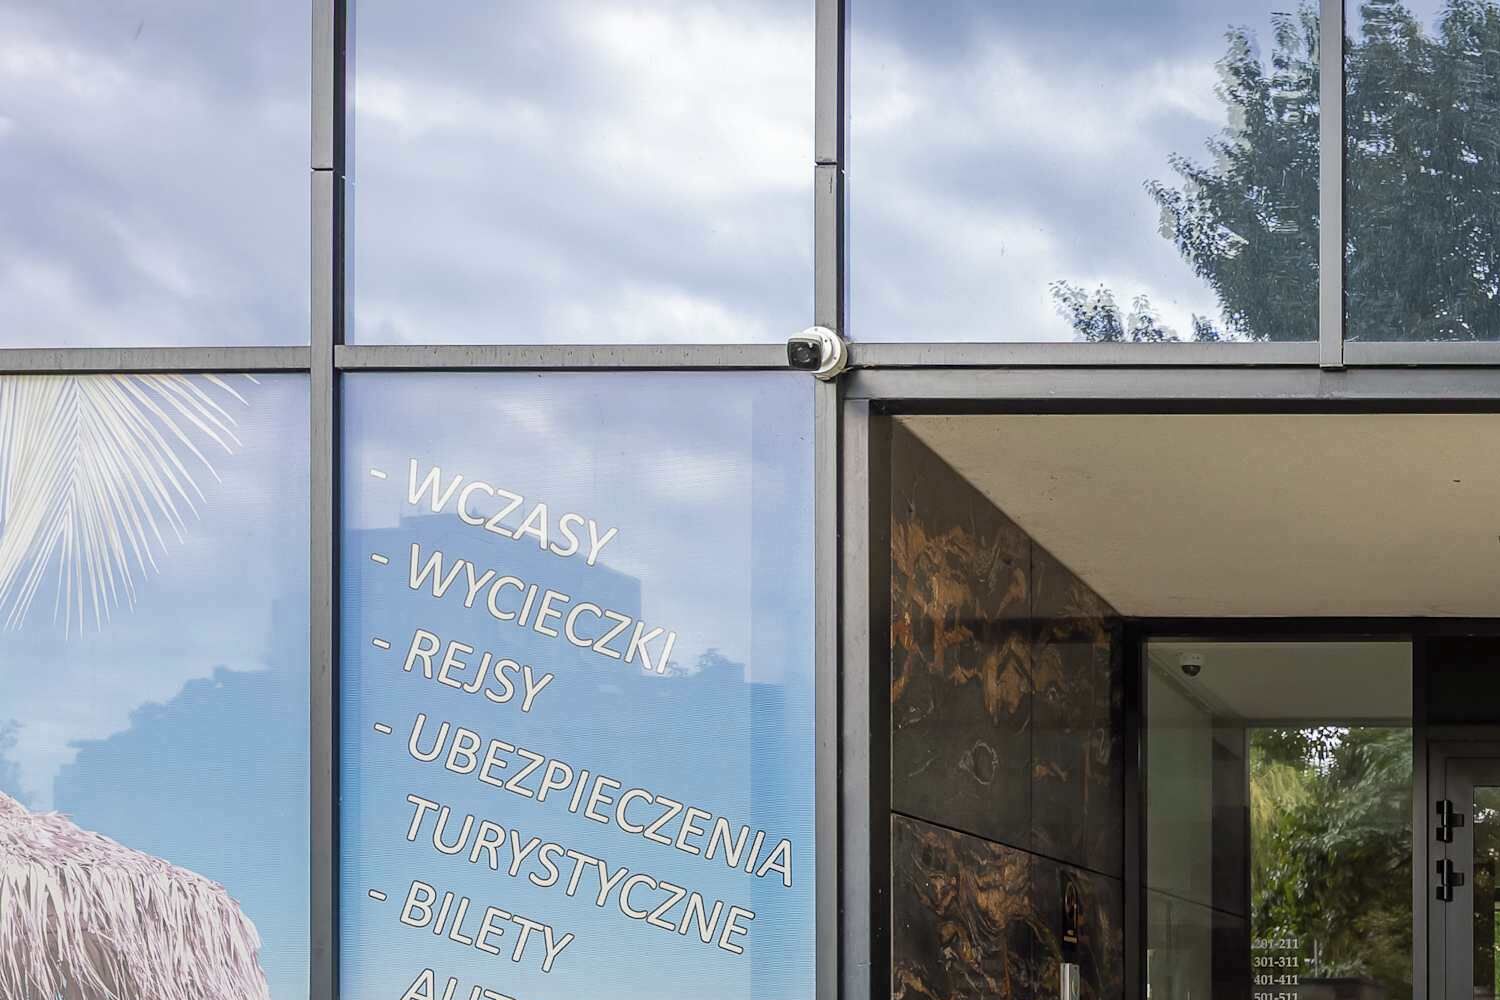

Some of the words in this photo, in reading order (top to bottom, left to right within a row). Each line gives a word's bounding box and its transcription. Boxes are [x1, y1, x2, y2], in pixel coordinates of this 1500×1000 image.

[407, 457, 619, 567] WCZASY
[408, 542, 677, 674] WYCIECZKI
[403, 628, 554, 713] REJSY
[407, 713, 793, 888] UBEZPIECZENIA
[406, 793, 755, 955] TURYSTYCZNE
[399, 879, 575, 974] BILETY
[1253, 956, 1300, 967] 301-311
[1253, 974, 1300, 985] 401-411
